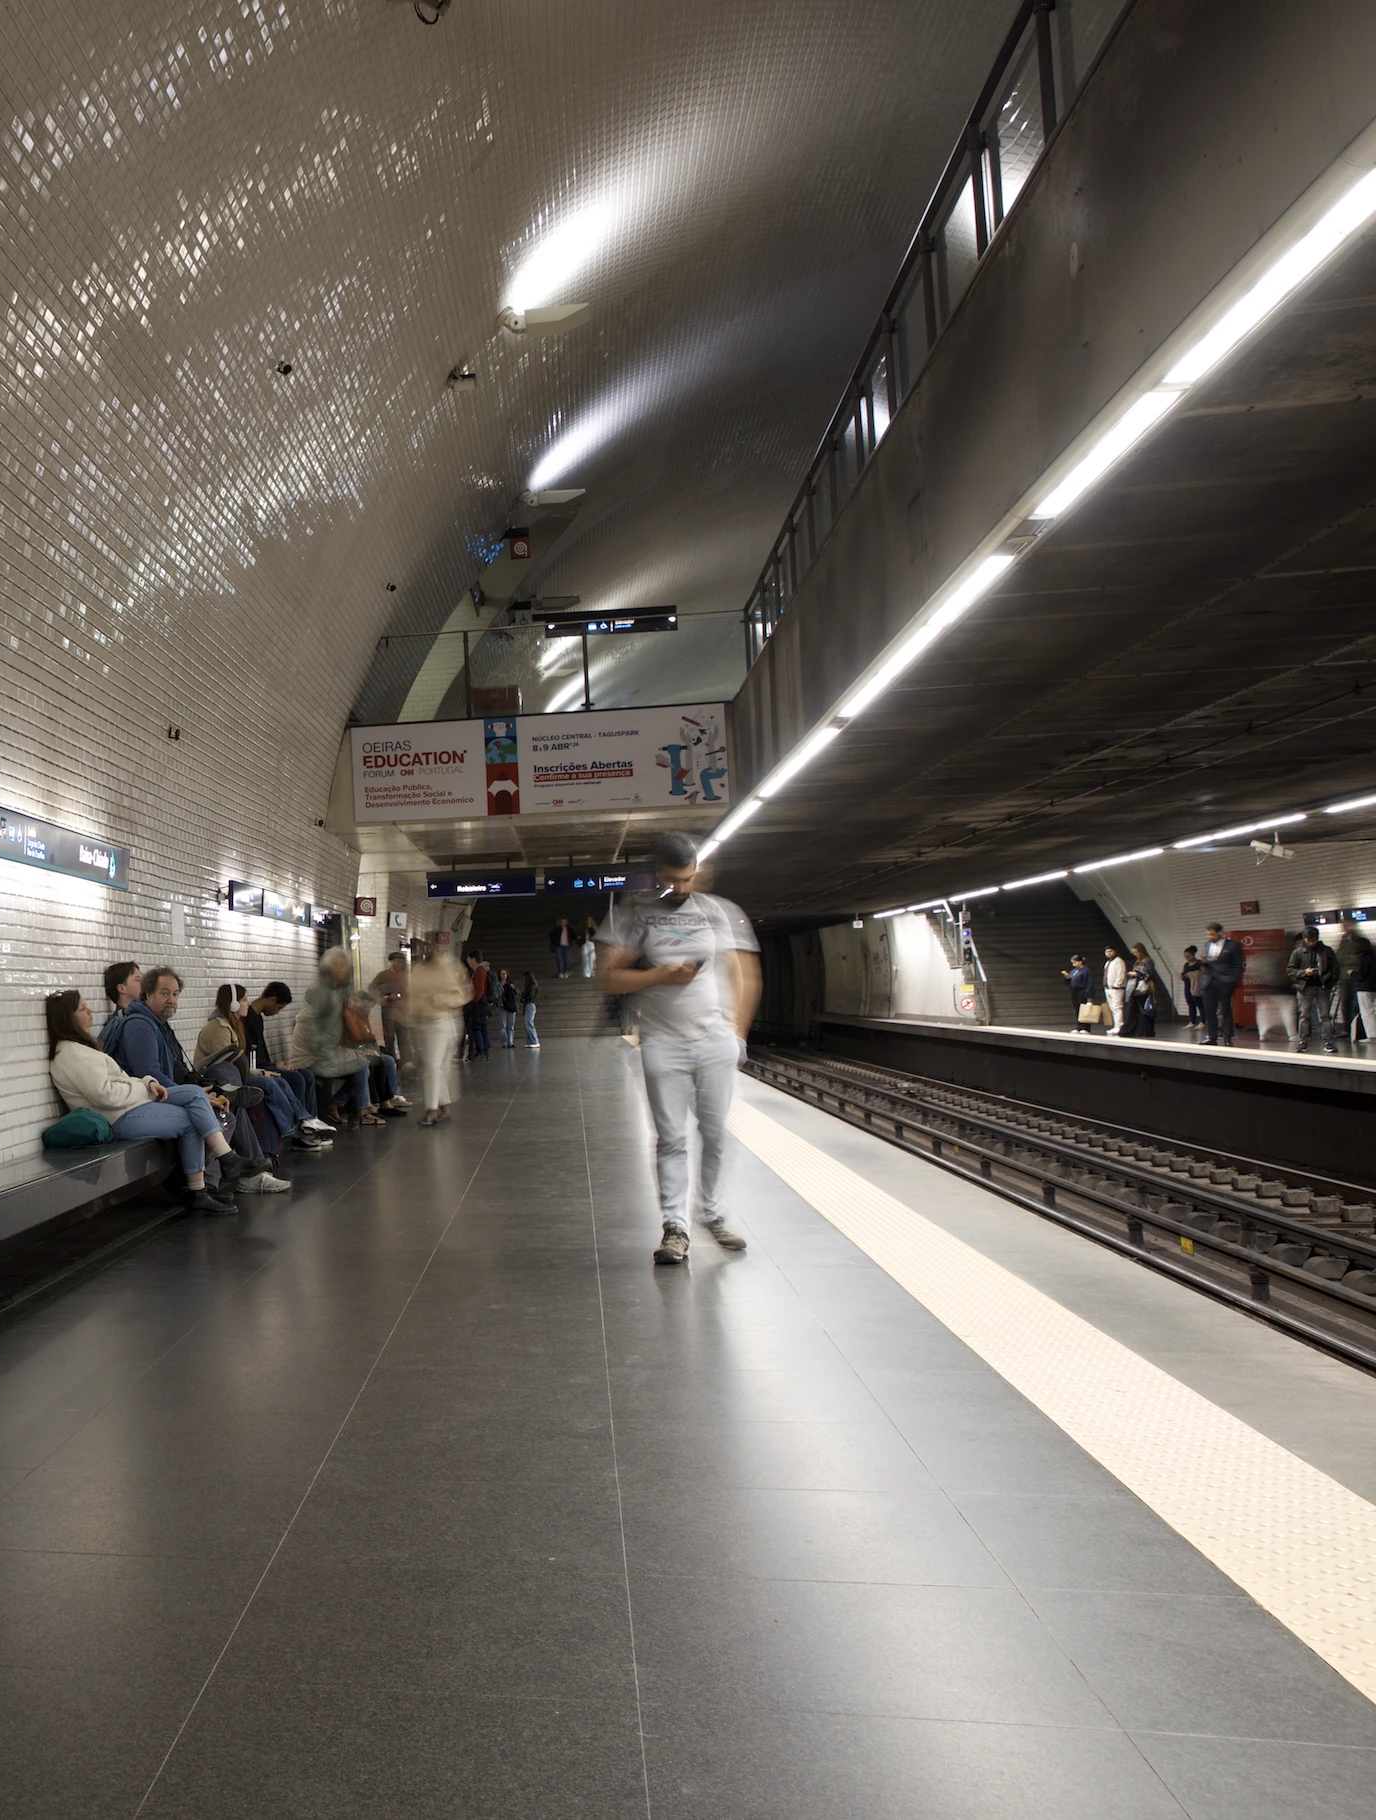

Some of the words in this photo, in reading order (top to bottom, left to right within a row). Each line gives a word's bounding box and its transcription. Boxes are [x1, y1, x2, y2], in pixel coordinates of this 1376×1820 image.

[561, 732, 592, 740] CENTRAL
[598, 729, 640, 738] TAGUSPARK
[362, 740, 412, 753] OEIRAS
[363, 769, 395, 779] FORUM
[399, 768, 415, 777] CNN
[418, 766, 465, 776] PORTUGAL
[533, 762, 588, 774] Inscrições
[590, 759, 634, 770] Abertas
[533, 772, 570, 782] Confirme
[578, 772, 593, 780] sua
[594, 770, 631, 779] presença
[364, 784, 401, 796] Educação
[402, 782, 433, 793] Pública,
[365, 790, 421, 802] Transformação
[422, 789, 446, 799] Social
[365, 798, 431, 809] Desenvolvimento
[432, 795, 474, 806] Económico
[645, 915, 707, 928] Reebok
